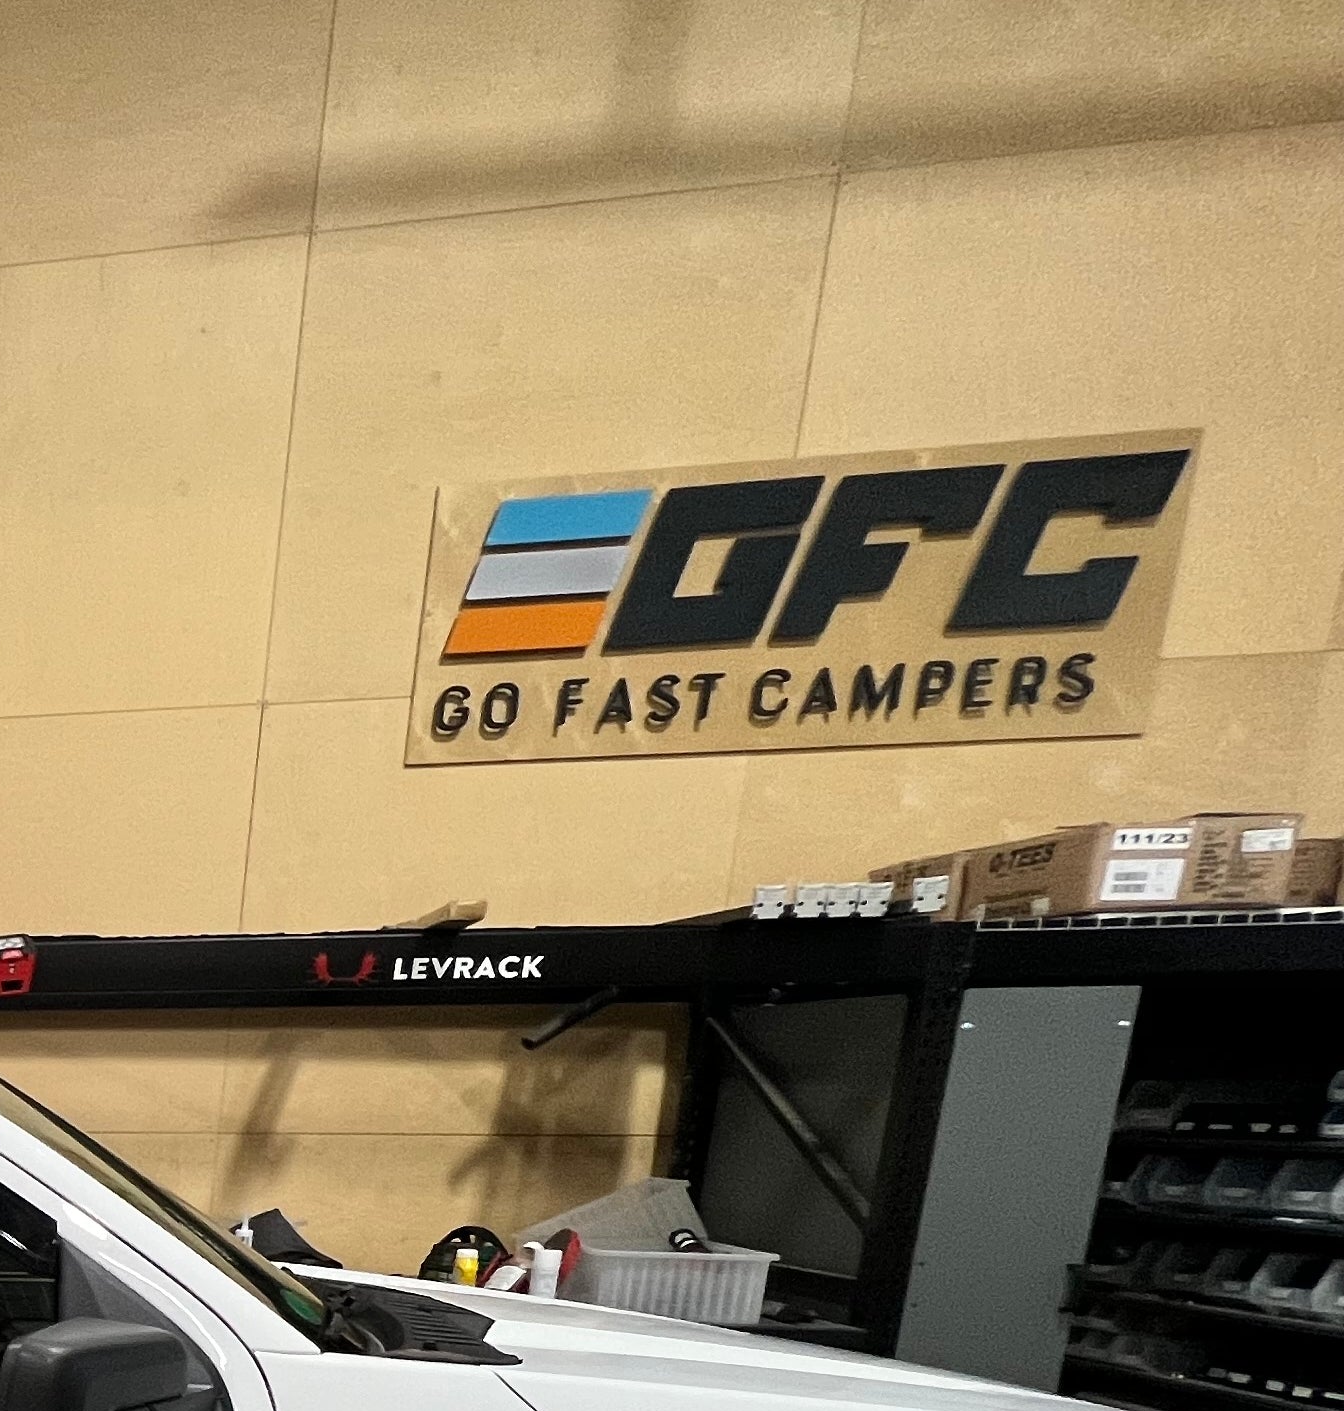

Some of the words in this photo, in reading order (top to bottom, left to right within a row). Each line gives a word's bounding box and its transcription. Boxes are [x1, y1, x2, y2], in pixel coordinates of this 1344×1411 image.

[601, 449, 1191, 658] GFC
[430, 681, 521, 738] GO
[553, 672, 727, 736] FAST
[747, 653, 1097, 725] CAMPERS
[1117, 832, 1191, 845] 111/23
[393, 955, 545, 981] LEVRACK
